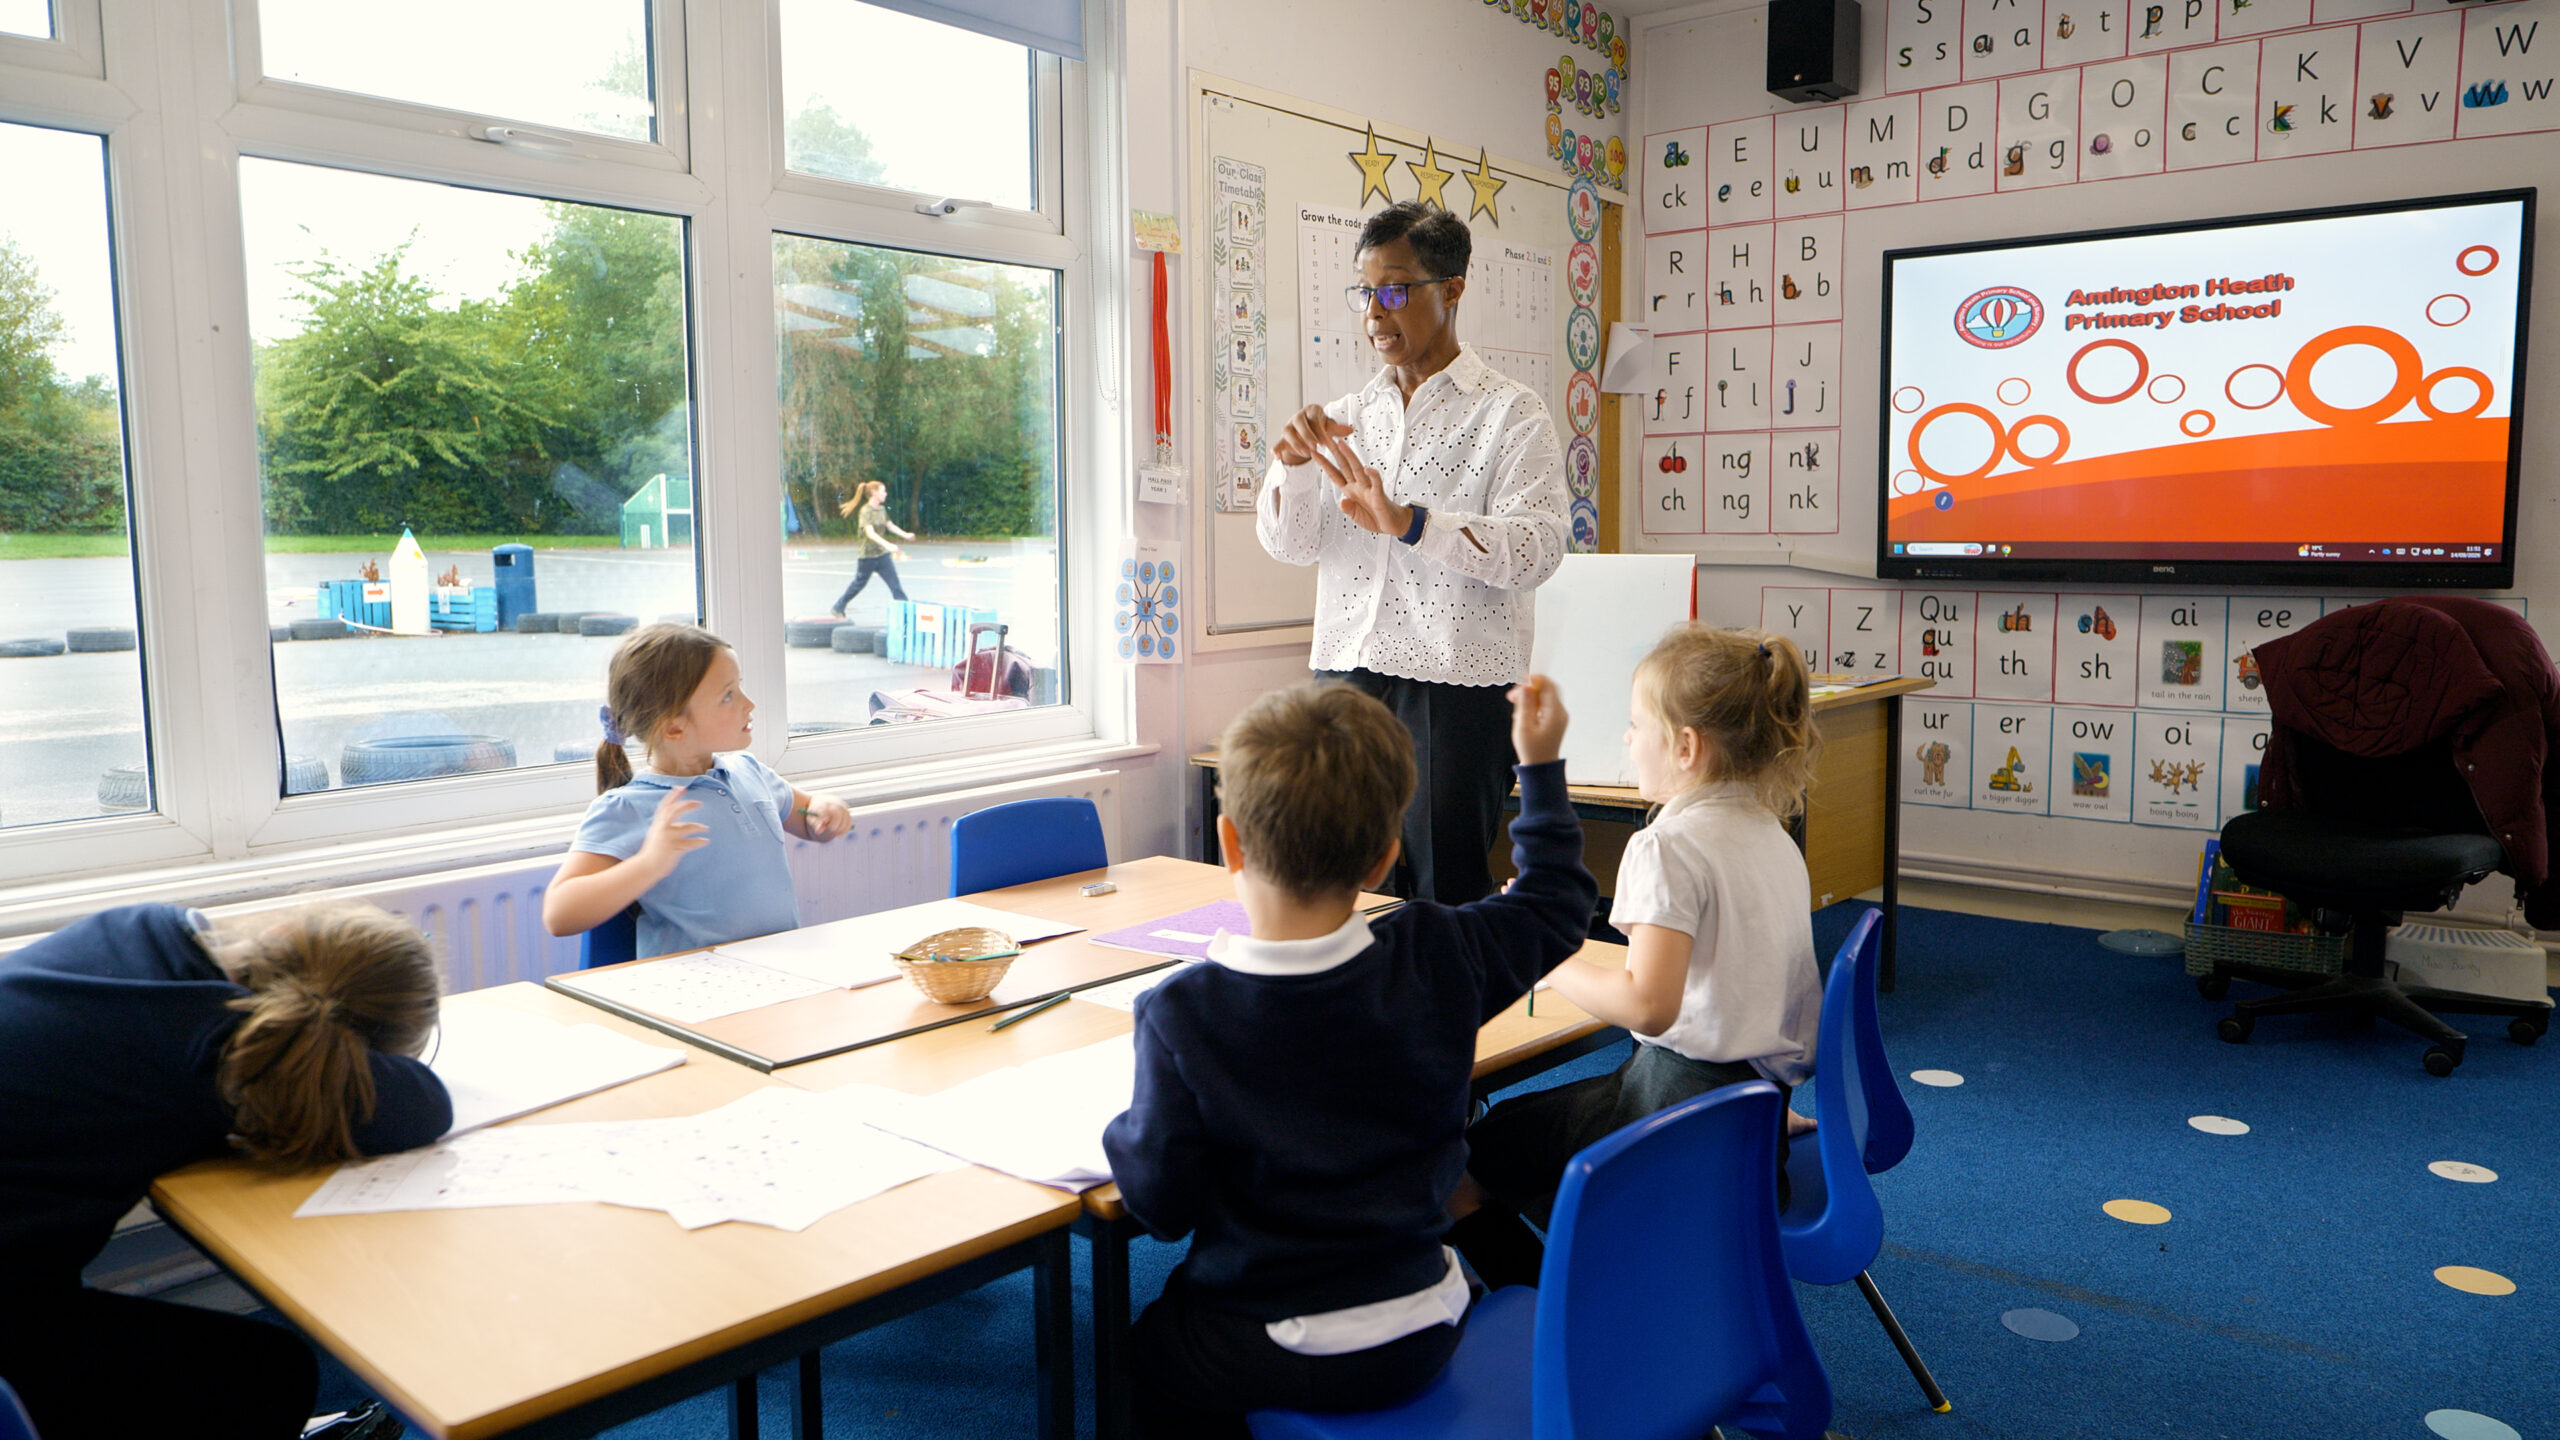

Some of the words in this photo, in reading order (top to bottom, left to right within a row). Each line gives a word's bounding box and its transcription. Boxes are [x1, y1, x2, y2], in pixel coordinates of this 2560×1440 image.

[1568, 3, 1578, 20] 87
[1585, 10, 1596, 27] 88
[1917, 0, 1932, 24] S
[2100, 11, 2110, 32] t
[2146, 4, 2163, 36] p
[2185, 0, 2202, 29] p
[1601, 20, 1611, 34] 89
[2014, 28, 2031, 46] a
[2495, 21, 2538, 57] W
[1614, 43, 1625, 58] 90
[1936, 43, 1947, 60] s
[2397, 37, 2423, 69] V
[1562, 63, 1573, 77] 94
[2298, 51, 2319, 82] K
[1548, 78, 1560, 92] 95
[1578, 78, 1590, 92] 93
[1594, 82, 1604, 96] 92
[1608, 75, 1618, 90] 91
[2202, 66, 2224, 95] C
[2522, 78, 2554, 101] w
[2112, 79, 2135, 108] O
[2421, 91, 2440, 112] v
[2028, 92, 2050, 121] G
[2320, 94, 2338, 125] k
[1550, 122, 1560, 136] 96
[1869, 115, 1894, 143] M
[1948, 105, 1968, 132] D
[2226, 115, 2240, 136] c
[1564, 136, 1575, 150] 97
[1801, 127, 1819, 153] U
[2134, 128, 2151, 148] o
[1580, 144, 1591, 157] 98
[1594, 148, 1604, 161] 99
[1610, 148, 1624, 164] 100
[1733, 137, 1748, 162] E
[1968, 142, 1984, 170] d
[2049, 139, 2065, 169] g
[1218, 163, 1237, 177] Our
[1239, 169, 1262, 184] Class
[1365, 160, 1380, 168] READY
[1886, 160, 1910, 180] m
[1420, 171, 1440, 181] RESPECT
[1818, 170, 1834, 189] u
[1218, 181, 1262, 200] Timetable
[1662, 184, 1688, 209] ck
[1750, 178, 1763, 197] e
[1301, 210, 1325, 223] Grow
[1328, 215, 1342, 226] the
[1344, 217, 1362, 229] code
[1505, 248, 1525, 261] Phase
[1732, 243, 1749, 268] H
[1801, 236, 1817, 261] B
[1669, 251, 1684, 275] R
[1750, 279, 1764, 303] h
[1817, 272, 1830, 297] b
[2065, 282, 2200, 308] Amington
[2206, 273, 2295, 298] Heath
[1687, 292, 1696, 308] r
[2065, 309, 2175, 332] Primary
[2180, 299, 2282, 323] School
[1669, 352, 1681, 376] F
[1732, 347, 1746, 371] L
[1800, 342, 1812, 367] J
[1682, 386, 1694, 419] f
[1752, 382, 1758, 407] l
[1815, 381, 1825, 413] j
[1722, 451, 1751, 478] ng
[1789, 443, 1819, 471] nk
[1661, 488, 1686, 511] ch
[1722, 492, 1750, 519] ng
[1789, 485, 1819, 509] nk
[1788, 604, 1803, 628] Y
[1856, 606, 1873, 631] Z
[1920, 595, 1958, 623] Qu
[2171, 602, 2198, 627] ai
[2257, 610, 2292, 629] ee
[1805, 649, 1817, 672] y
[1874, 653, 1886, 669] z
[1921, 660, 1953, 680] qu
[2000, 650, 2028, 676] th
[2080, 653, 2112, 680] sh
[2152, 690, 2165, 698] tail
[2168, 690, 2176, 698] in
[2178, 691, 2192, 699] the
[2194, 692, 2211, 701] rain
[2238, 694, 2264, 704] sheep
[1923, 711, 1950, 730] ur
[2000, 716, 2026, 734] er
[2072, 720, 2114, 740] ow
[2164, 722, 2192, 745] oi
[1914, 787, 1928, 796] curl
[1930, 788, 1941, 797] the
[1942, 790, 1954, 799] fur
[1989, 794, 2012, 804] bigger
[2015, 794, 2039, 806] digger
[2094, 802, 2108, 811] owl
[2149, 808, 2172, 819] boing
[2175, 808, 2200, 820] boing
[2234, 916, 2272, 931] GIANT
